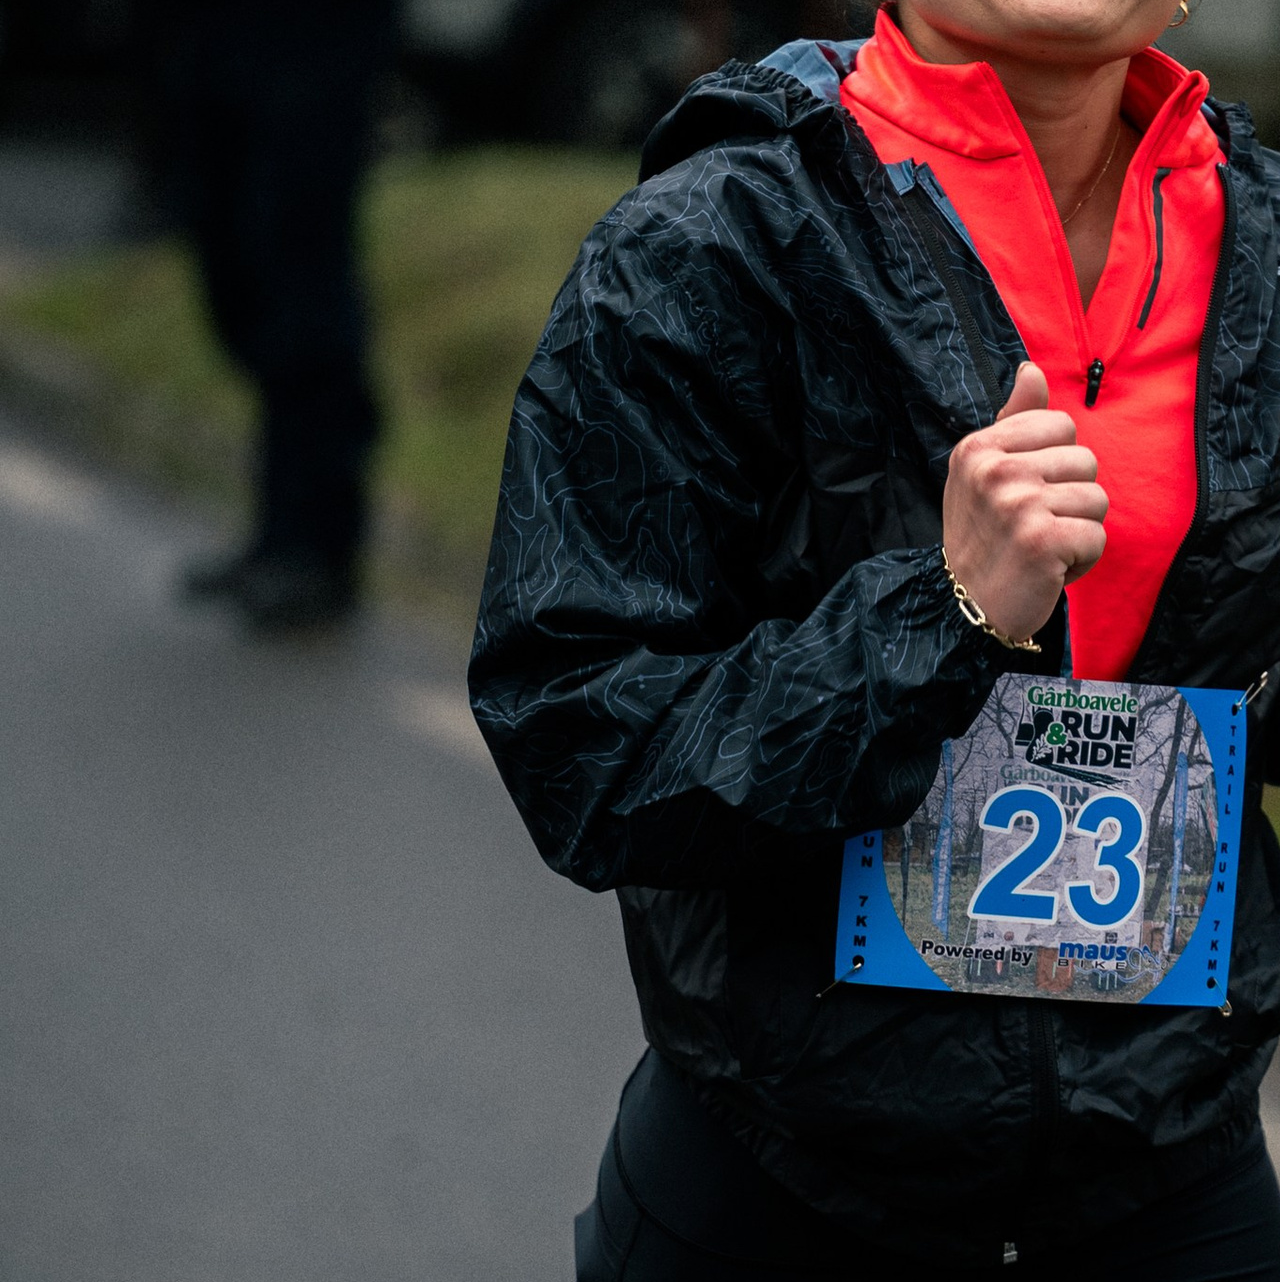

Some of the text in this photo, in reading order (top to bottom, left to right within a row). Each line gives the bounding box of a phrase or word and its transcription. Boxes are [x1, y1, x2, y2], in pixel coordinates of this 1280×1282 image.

[1027, 685, 1138, 713] Gârboavele
[1045, 722, 1067, 746] &
[1060, 710, 1137, 742] RUN
[1056, 739, 1133, 769] RIDE
[1225, 725, 1237, 815] TRAIL
[969, 786, 1145, 928] 23
[1216, 842, 1228, 893] RUN
[921, 940, 1034, 966] Powered by
[1058, 941, 1128, 961] maus
[1058, 958, 1128, 970] BIKE
